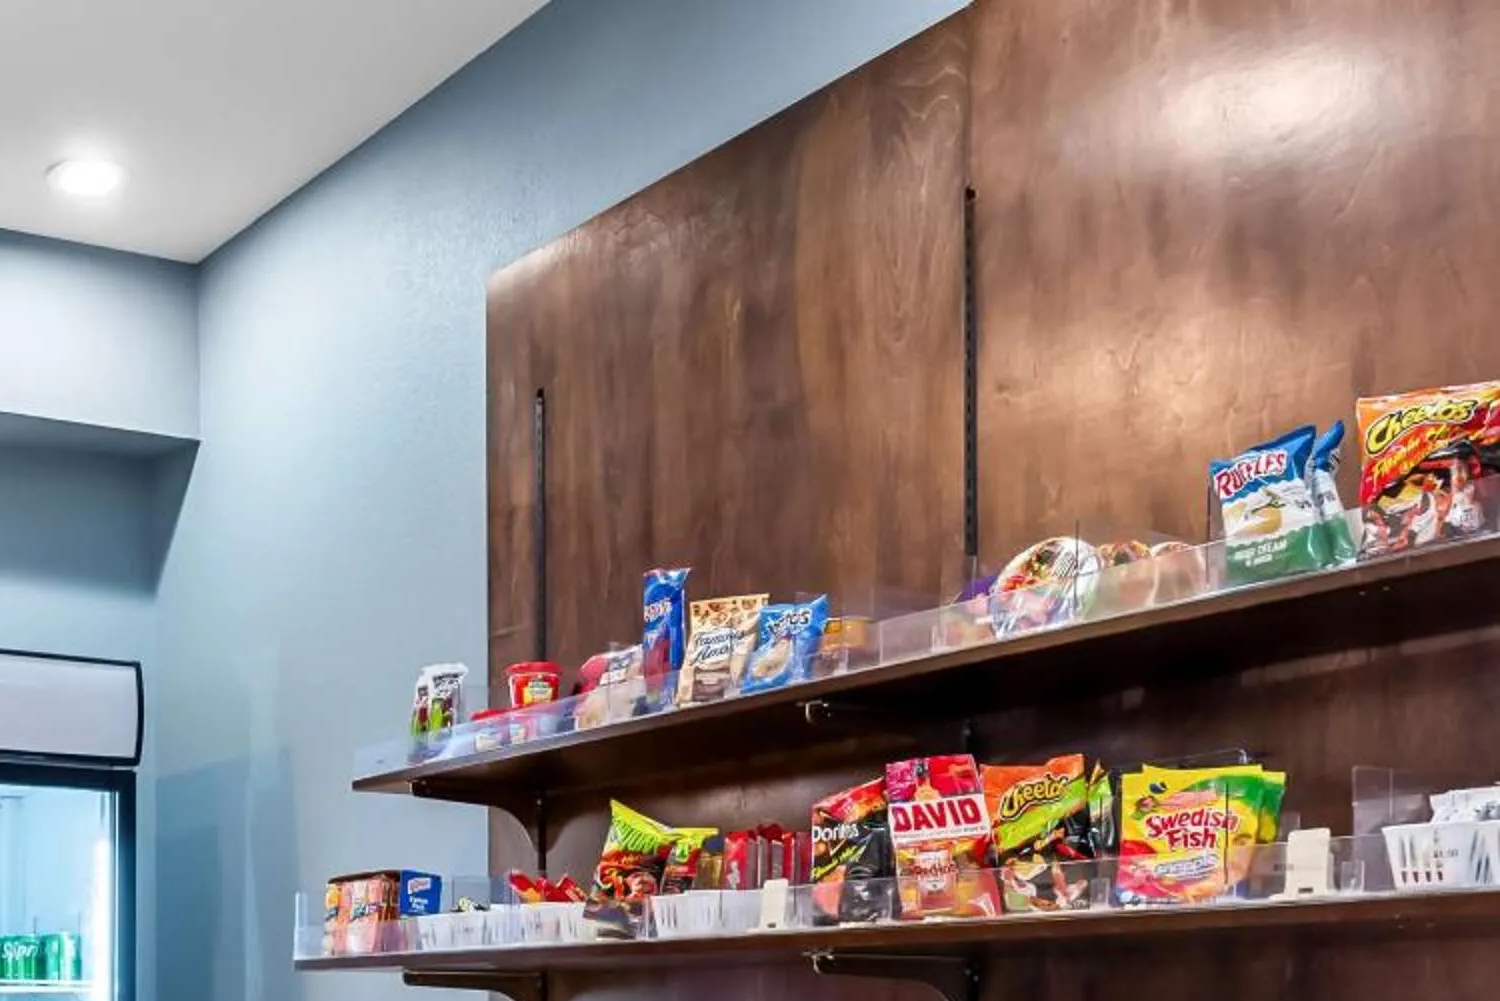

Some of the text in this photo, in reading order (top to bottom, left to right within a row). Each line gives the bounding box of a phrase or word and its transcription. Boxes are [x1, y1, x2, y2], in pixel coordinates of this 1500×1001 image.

[1367, 399, 1479, 454] Cheetos
[1215, 453, 1287, 497] RUFFLES
[1002, 776, 1069, 816] Cheeto
[811, 822, 860, 843] Doritos
[891, 798, 982, 833] DAVID
[1146, 808, 1239, 838] Swedish
[1165, 829, 1217, 850] Fish
